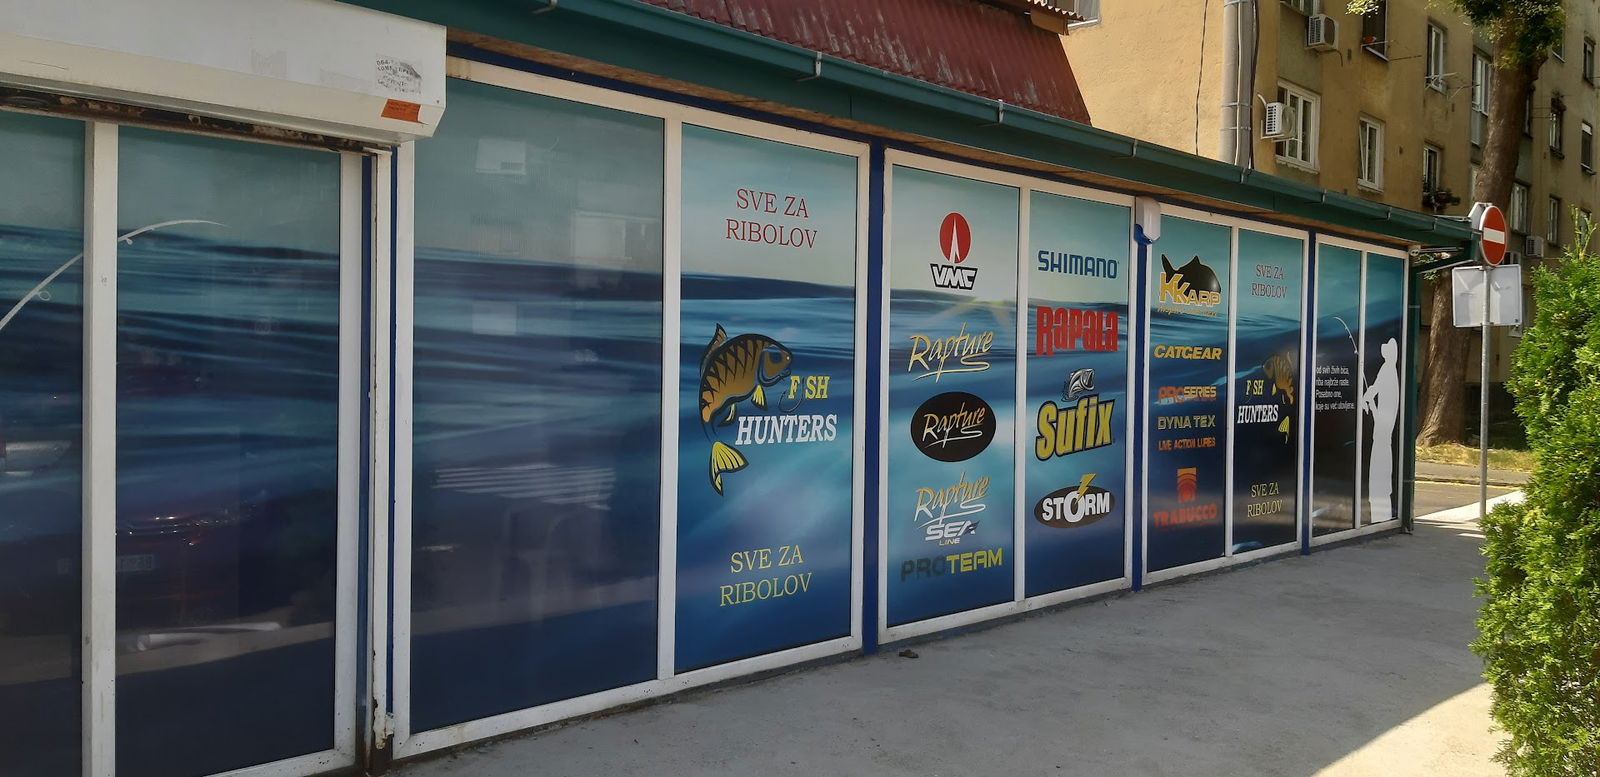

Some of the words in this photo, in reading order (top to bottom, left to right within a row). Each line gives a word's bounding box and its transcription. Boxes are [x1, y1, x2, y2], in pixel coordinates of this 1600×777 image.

[736, 188, 778, 214] SVE
[783, 196, 809, 218] ZA
[726, 218, 818, 249] RIBOLOV
[930, 263, 978, 290] VMC
[1038, 250, 1118, 279] SHIMANO
[1255, 264, 1272, 279] SVE
[1273, 266, 1285, 280] ZA
[1251, 282, 1287, 299] RIBOLOV
[907, 322, 994, 383] Rapture
[1153, 344, 1222, 360] CATGEAR
[922, 402, 986, 448] Rapture
[1035, 394, 1115, 461] Sufix
[1157, 415, 1192, 430] DYNA
[1193, 414, 1216, 428] TEX
[1237, 404, 1279, 424] HUNTERS
[735, 414, 838, 445] HUNTERS
[1158, 439, 1172, 451] LIVE
[1173, 438, 1196, 449] ACTION
[913, 471, 990, 529] Rapture
[1251, 484, 1267, 498] SVE
[1268, 482, 1280, 496] ZA
[1042, 490, 1110, 523] STORM
[1247, 499, 1283, 518] RIBOLOV
[939, 537, 961, 546] LINE
[731, 548, 772, 573] SVE
[778, 544, 804, 567] ZA
[720, 572, 812, 607] RIBOLOV
